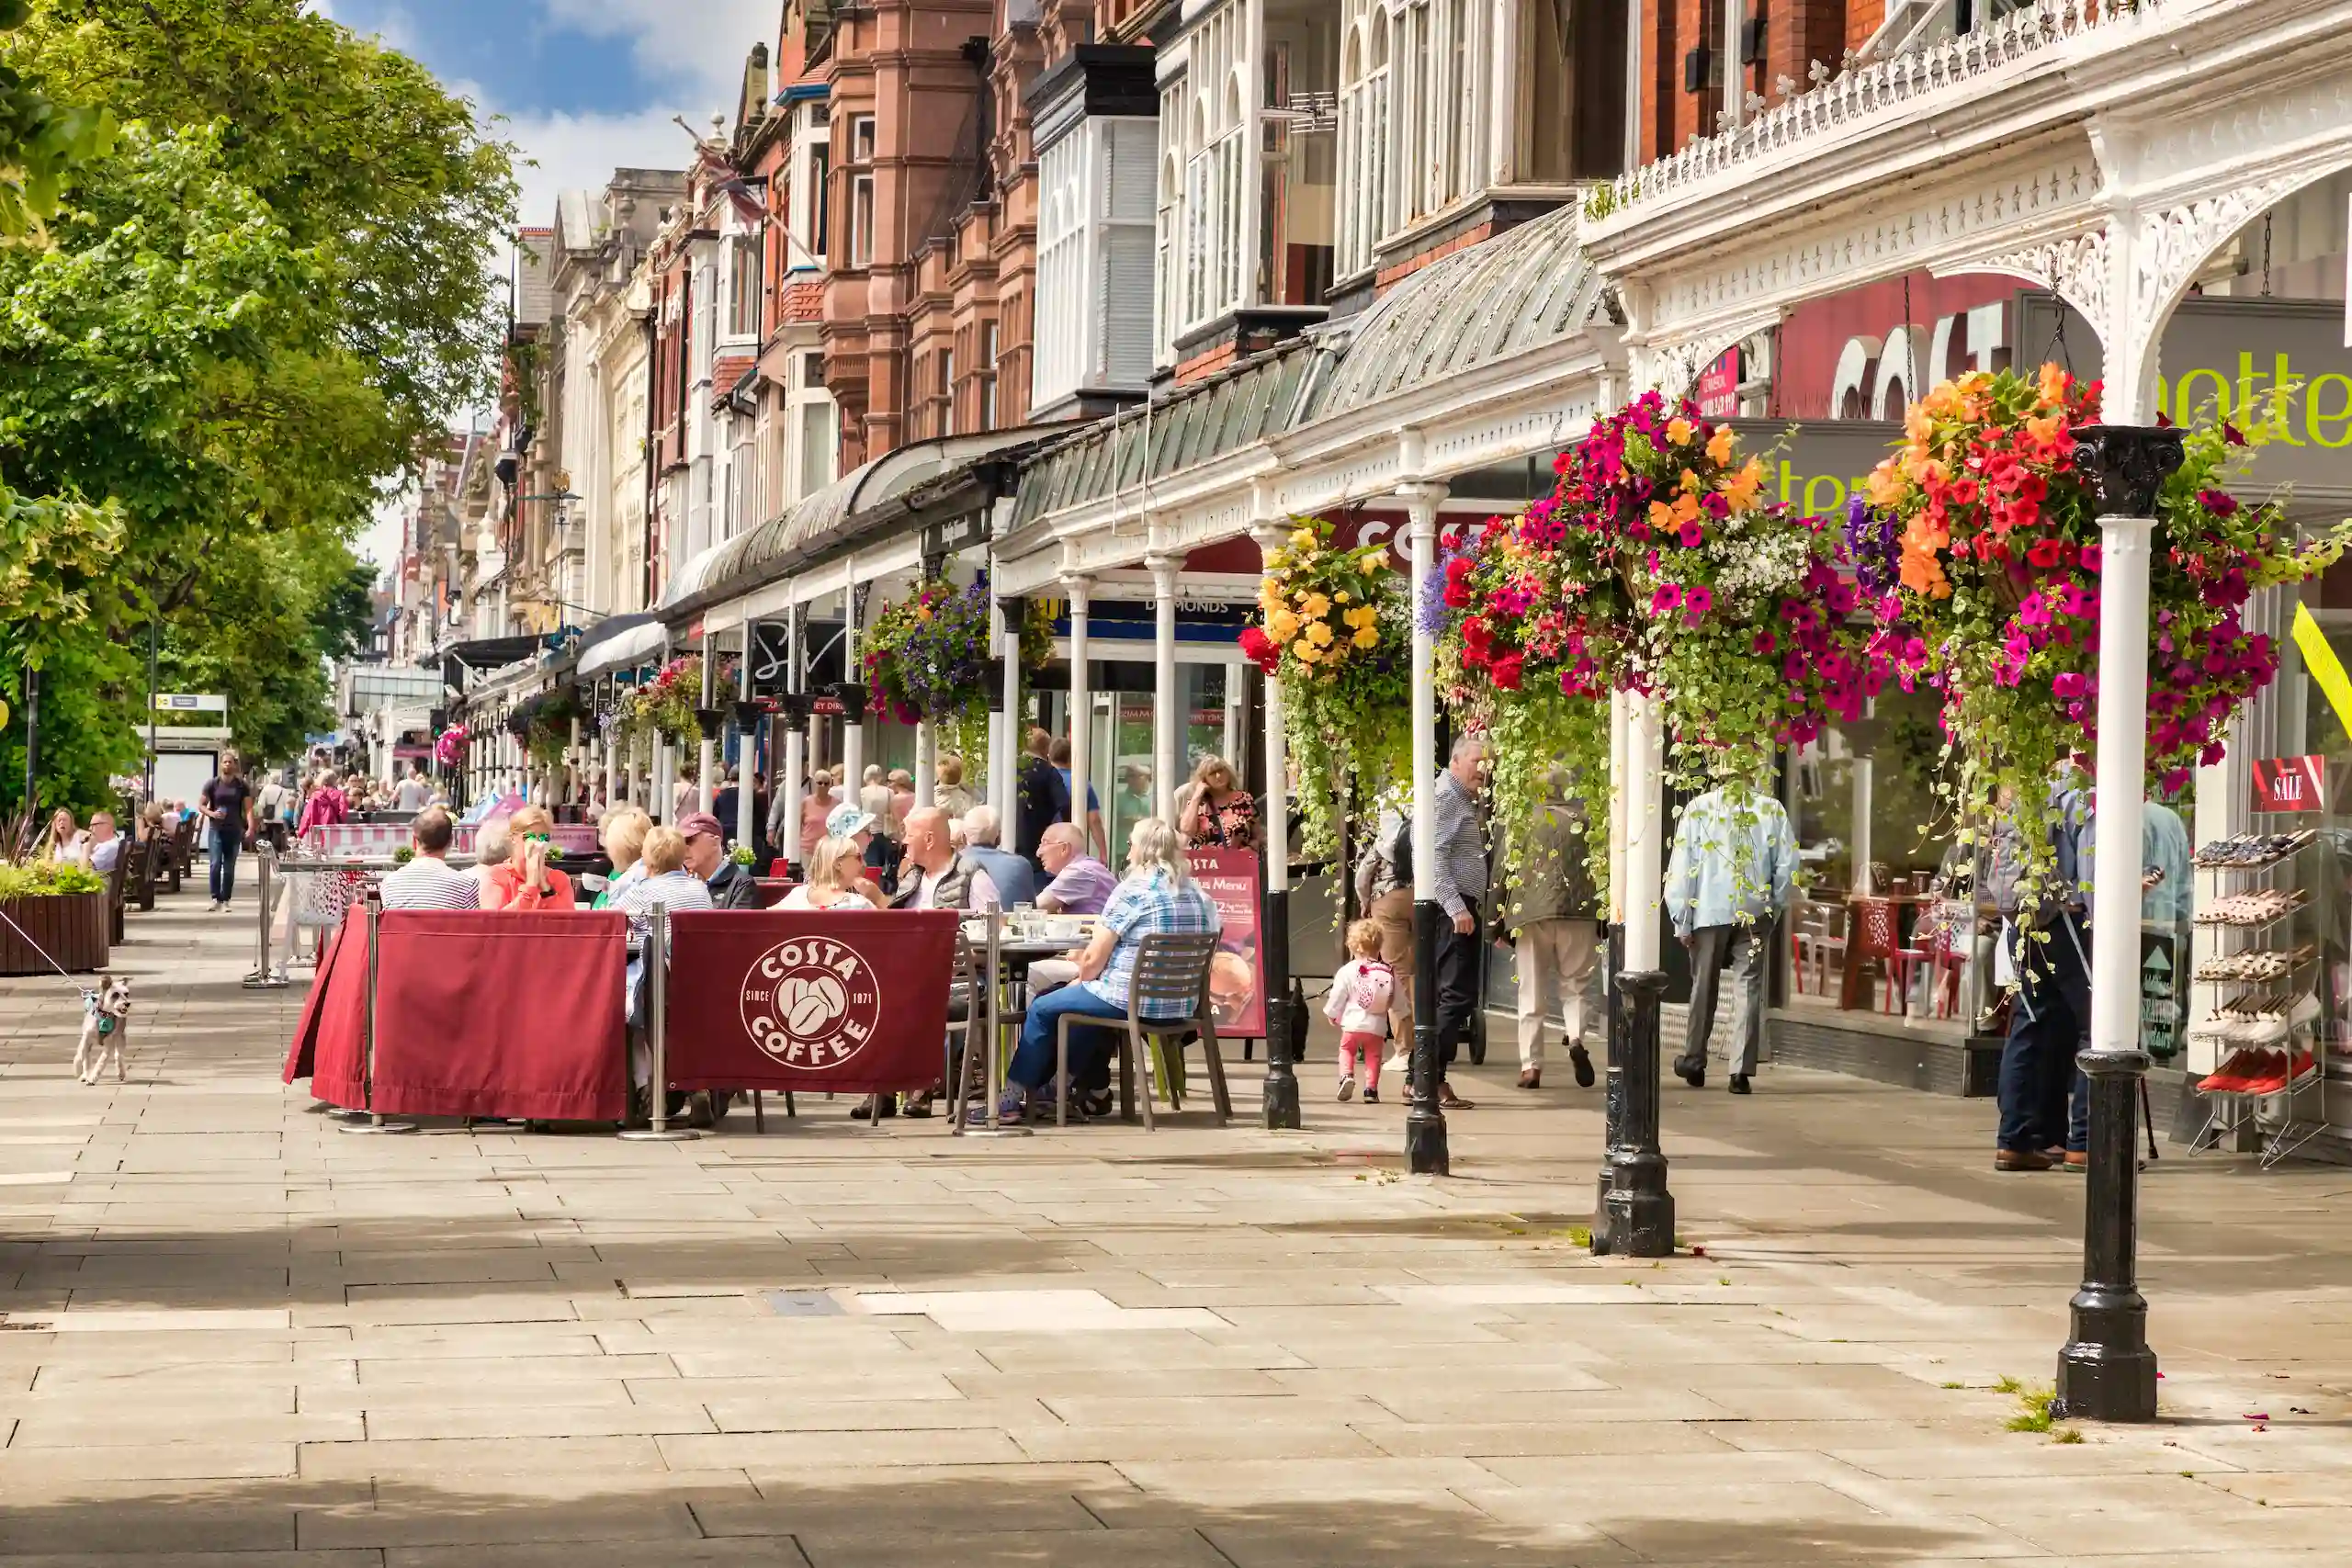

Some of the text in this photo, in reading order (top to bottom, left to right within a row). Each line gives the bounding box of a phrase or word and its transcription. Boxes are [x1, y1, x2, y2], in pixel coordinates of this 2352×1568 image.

[2159, 352, 2352, 448] otte
[1145, 600, 1228, 614] DMONDS
[2274, 775, 2302, 801] SALE
[1213, 877, 1247, 891] Menu
[761, 941, 858, 982] COSTA
[746, 989, 769, 1002] SINCE
[853, 993, 872, 1004] 1971
[752, 1016, 868, 1065] COFFEE
